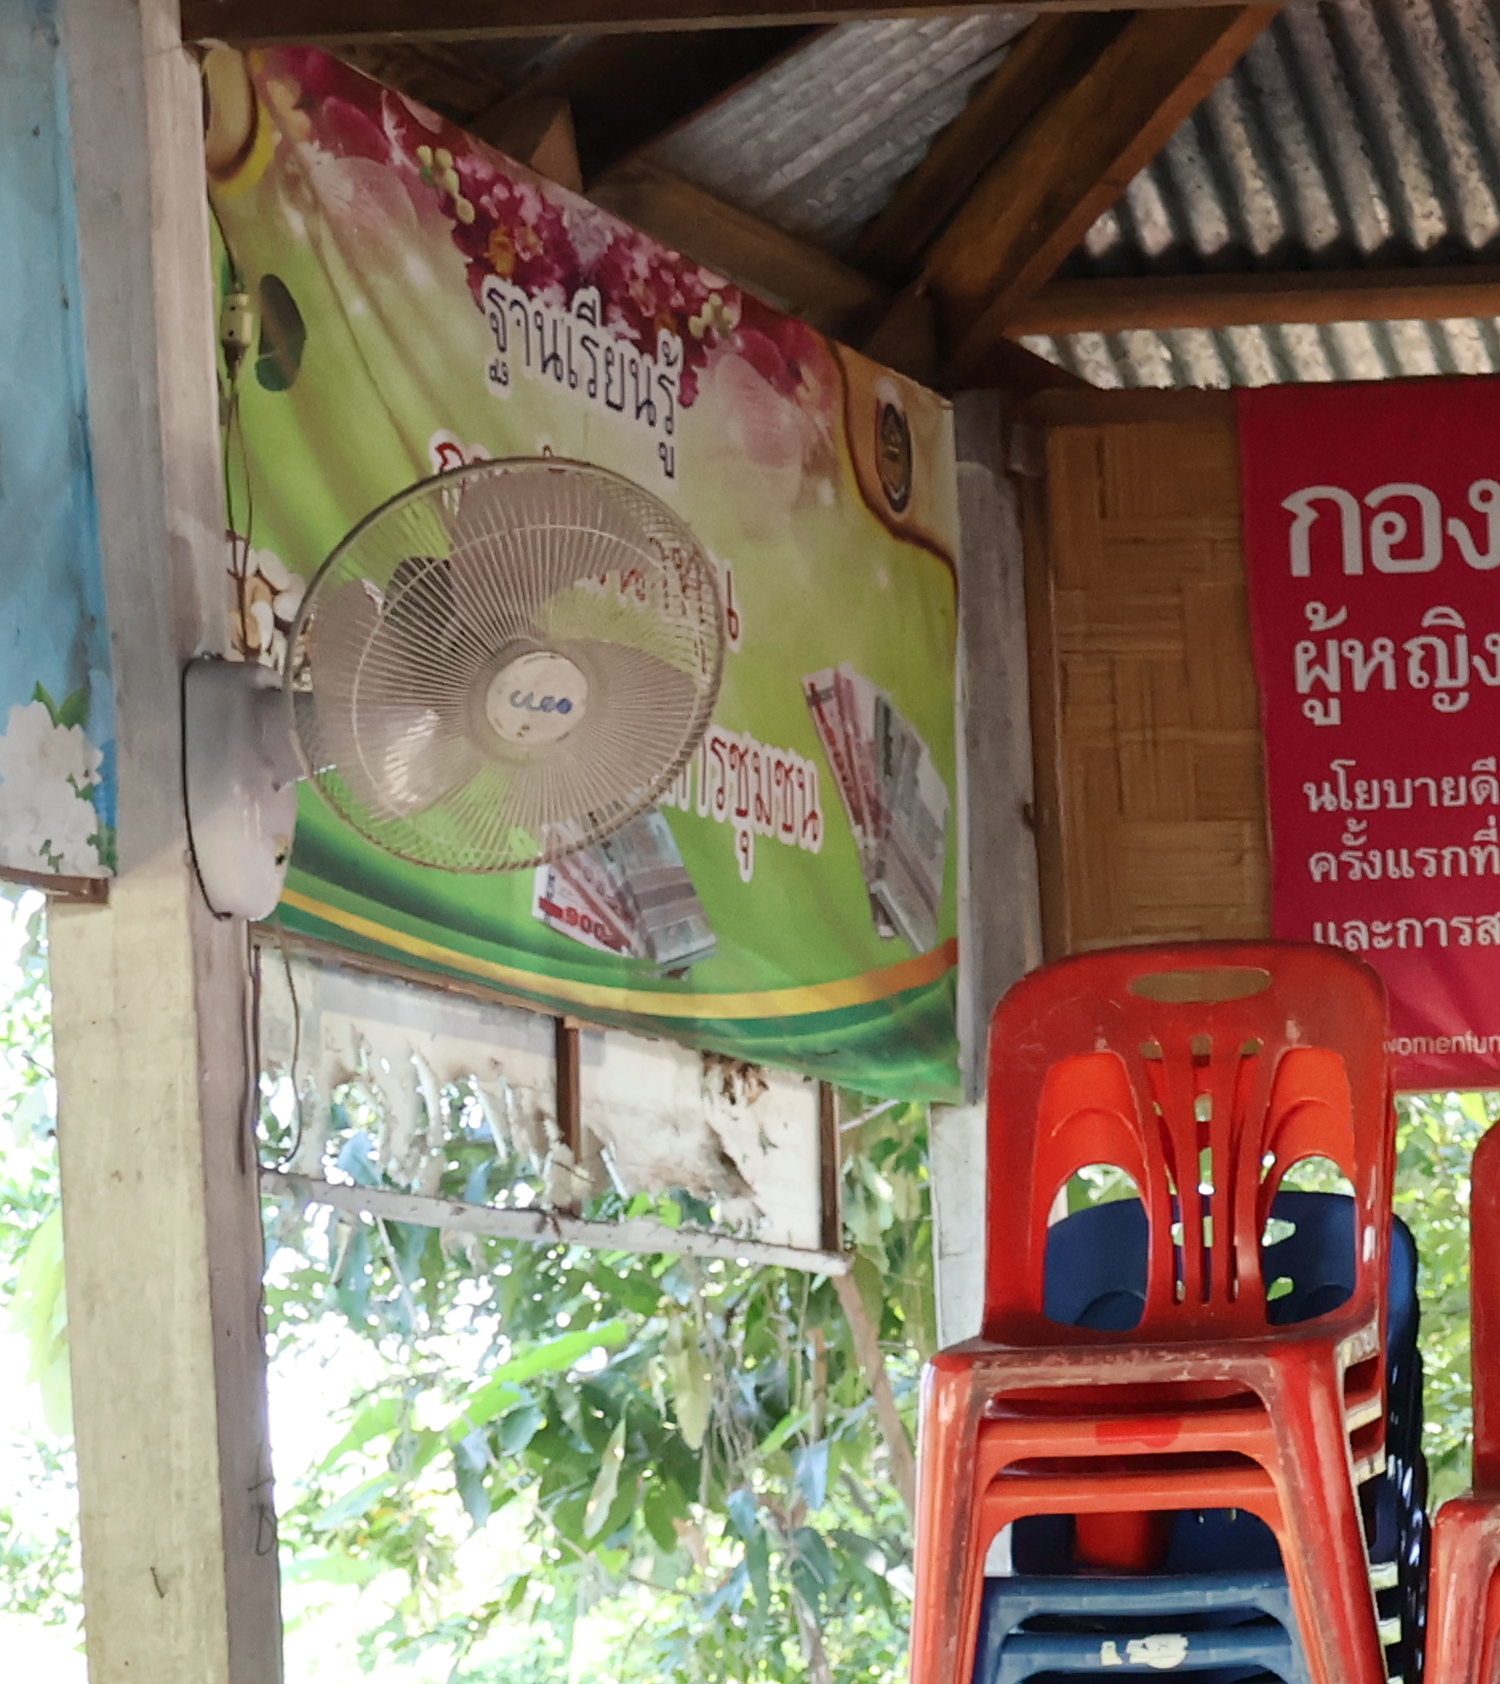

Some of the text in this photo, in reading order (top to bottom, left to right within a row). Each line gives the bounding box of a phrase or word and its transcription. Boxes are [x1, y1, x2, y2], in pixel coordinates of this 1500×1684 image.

[487, 287, 681, 478] ฐานเรียนรู้
